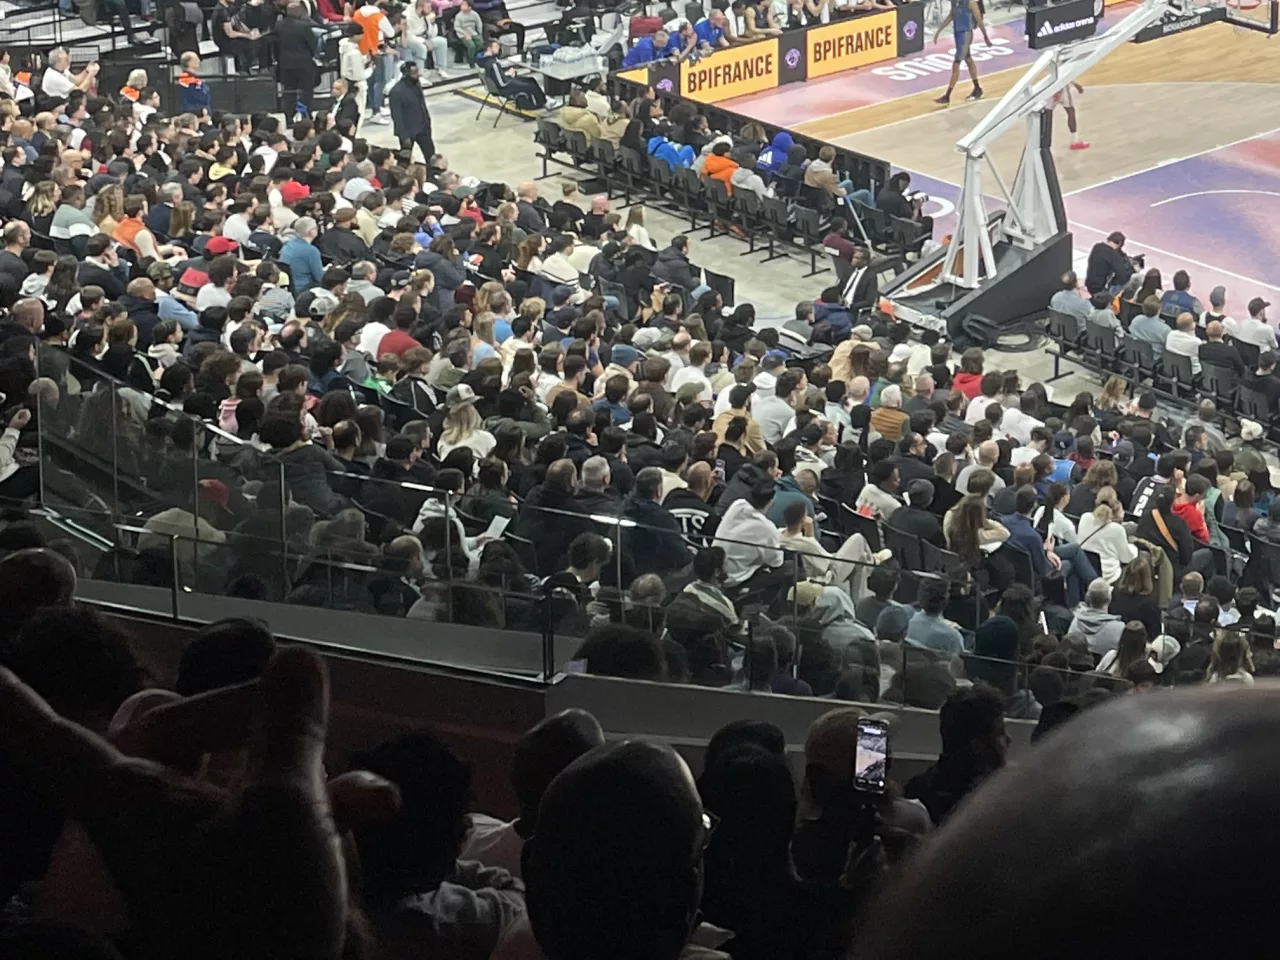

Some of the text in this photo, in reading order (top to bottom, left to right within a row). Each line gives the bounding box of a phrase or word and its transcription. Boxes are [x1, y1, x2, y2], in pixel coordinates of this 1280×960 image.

[1053, 16, 1095, 33] adidas arena
[812, 25, 893, 63] BPIFRANCE
[687, 52, 773, 93] BPIFRANCE
